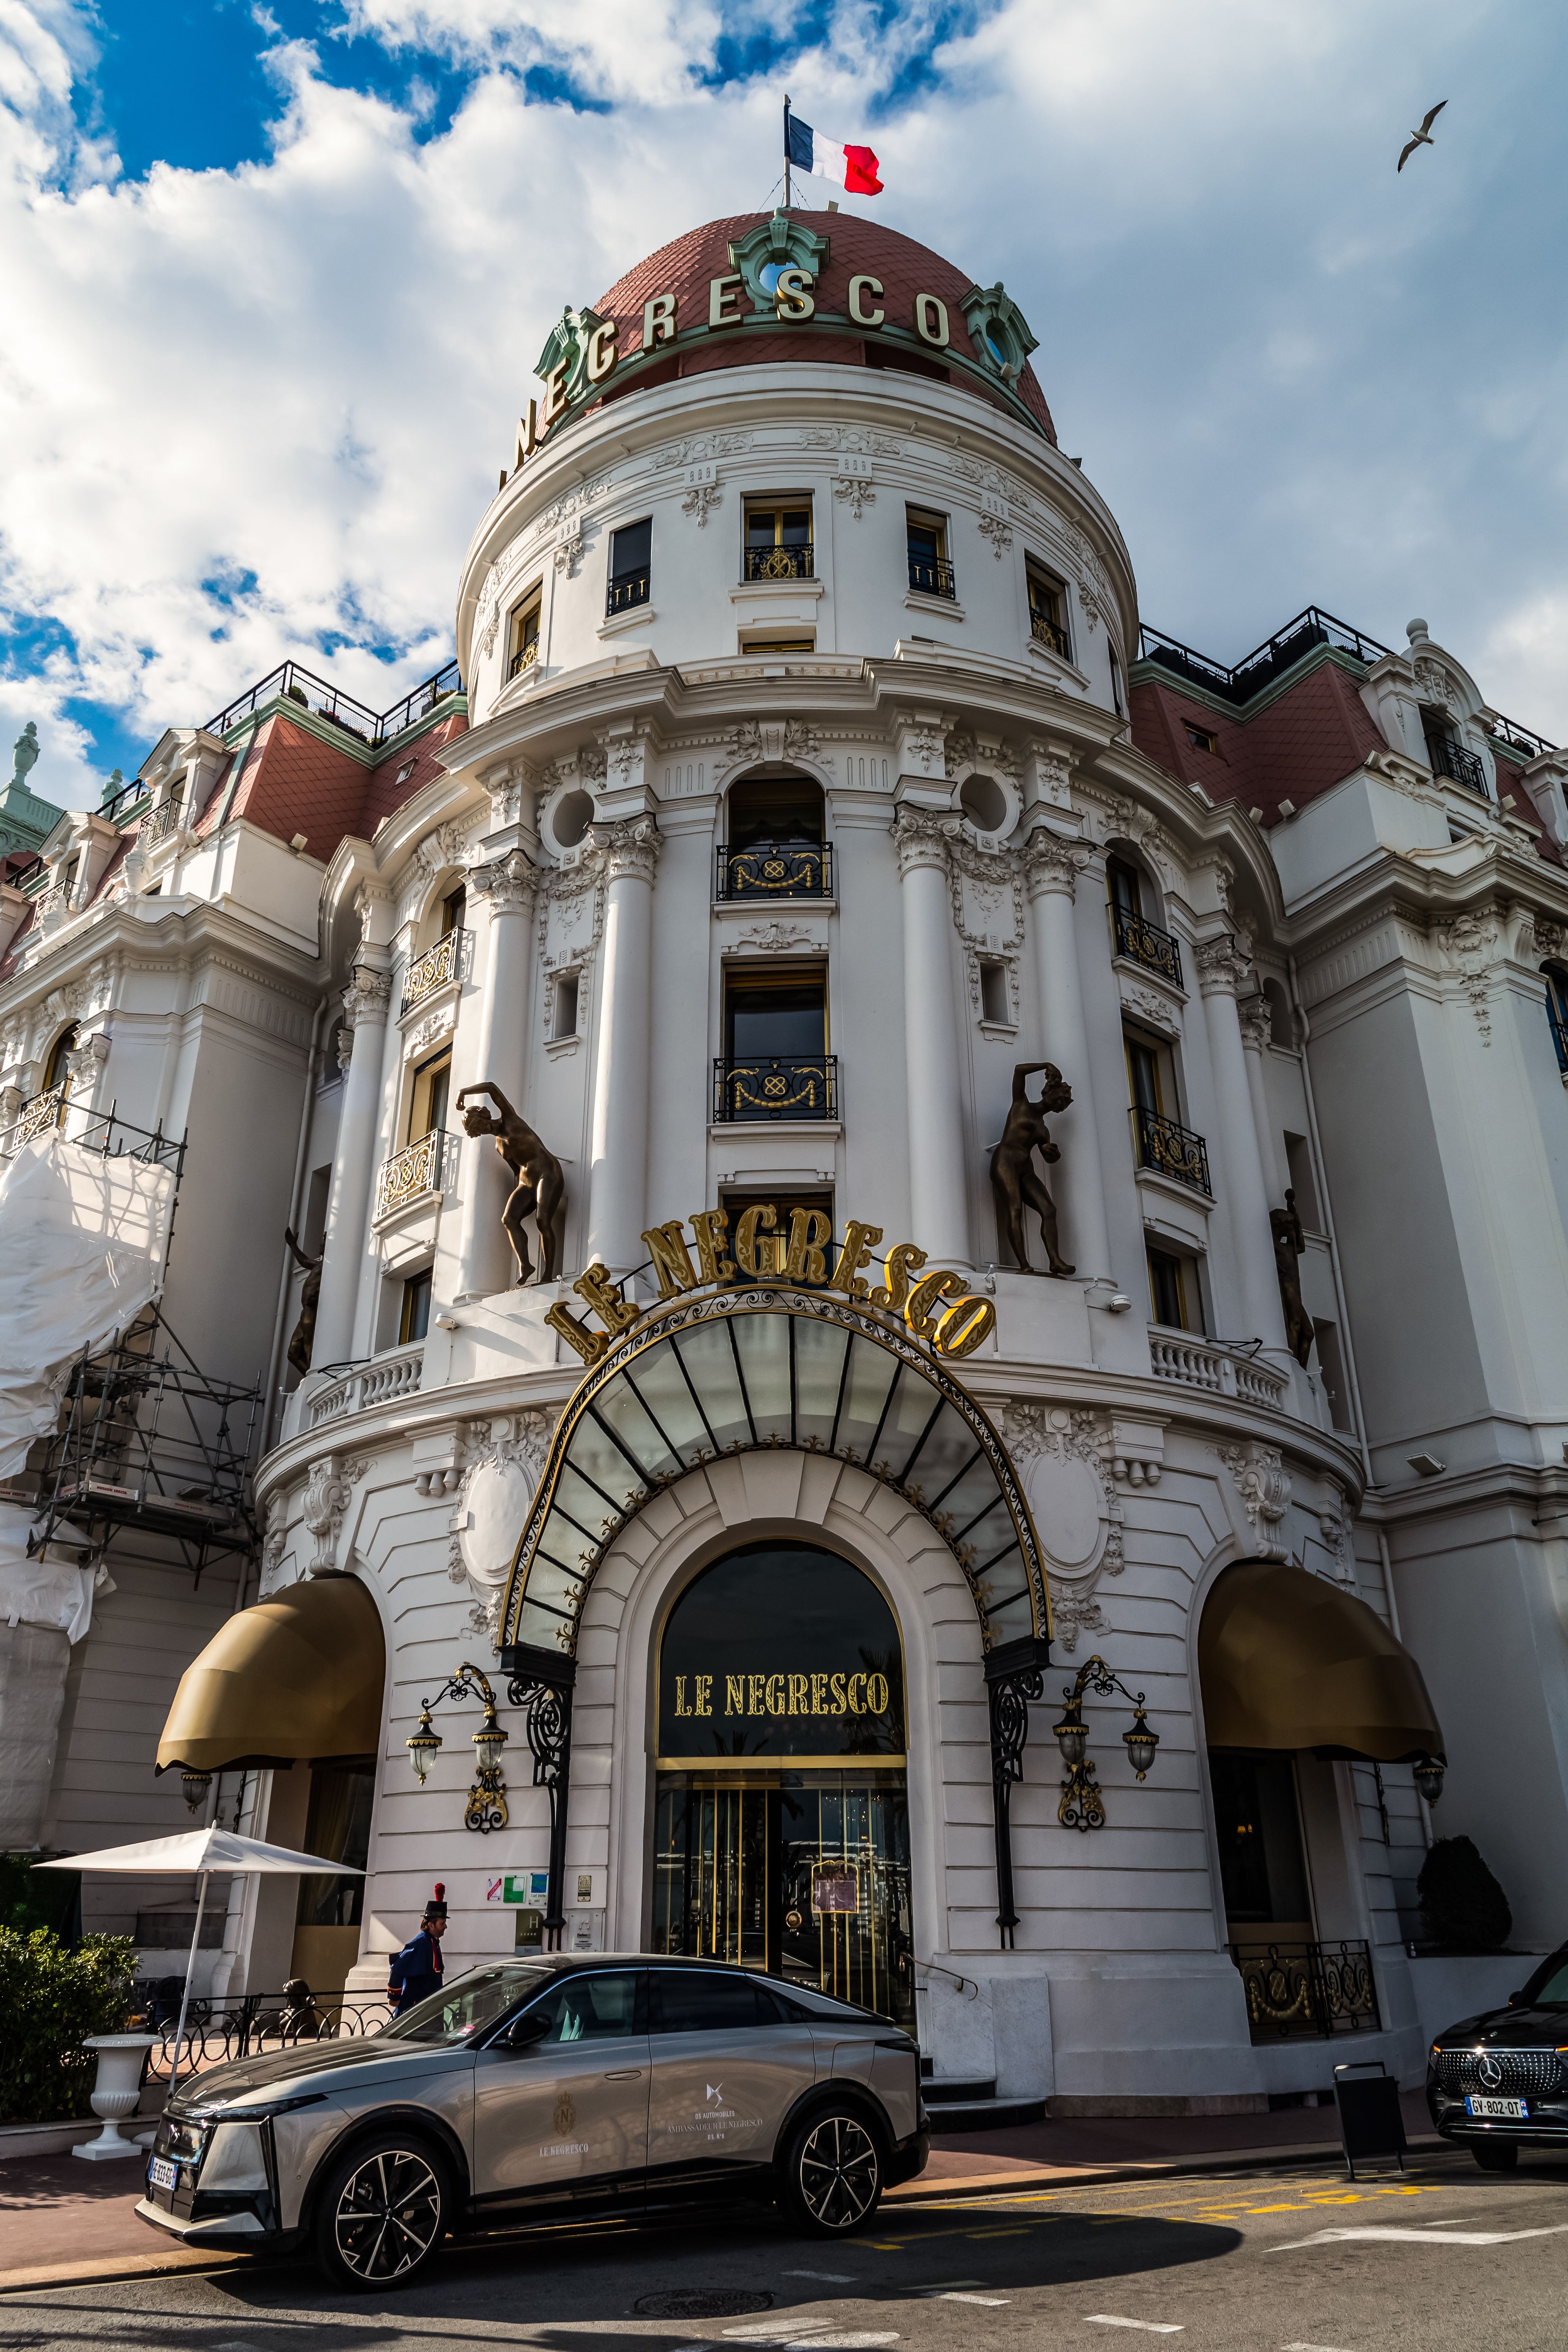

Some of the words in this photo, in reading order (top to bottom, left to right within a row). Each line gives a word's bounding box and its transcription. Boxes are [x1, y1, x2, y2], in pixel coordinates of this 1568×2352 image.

[514, 268, 950, 473] NEGRESCO
[544, 1263, 642, 1367] LE
[640, 1204, 996, 1359] NEGRESCO
[674, 1675, 713, 1716] LE
[724, 1672, 888, 1716] NEGRESCO
[529, 1916, 539, 1928] H
[703, 2110, 735, 2119] AUTOMOBILES
[1472, 2100, 1519, 2115] GV-802-QT
[561, 2108, 569, 2123] N
[667, 2122, 718, 2133] AMBASSADEUR
[729, 2119, 763, 2128] NEGRESCO
[540, 2147, 548, 2157] LE
[550, 2143, 589, 2155] NEGRESCO
